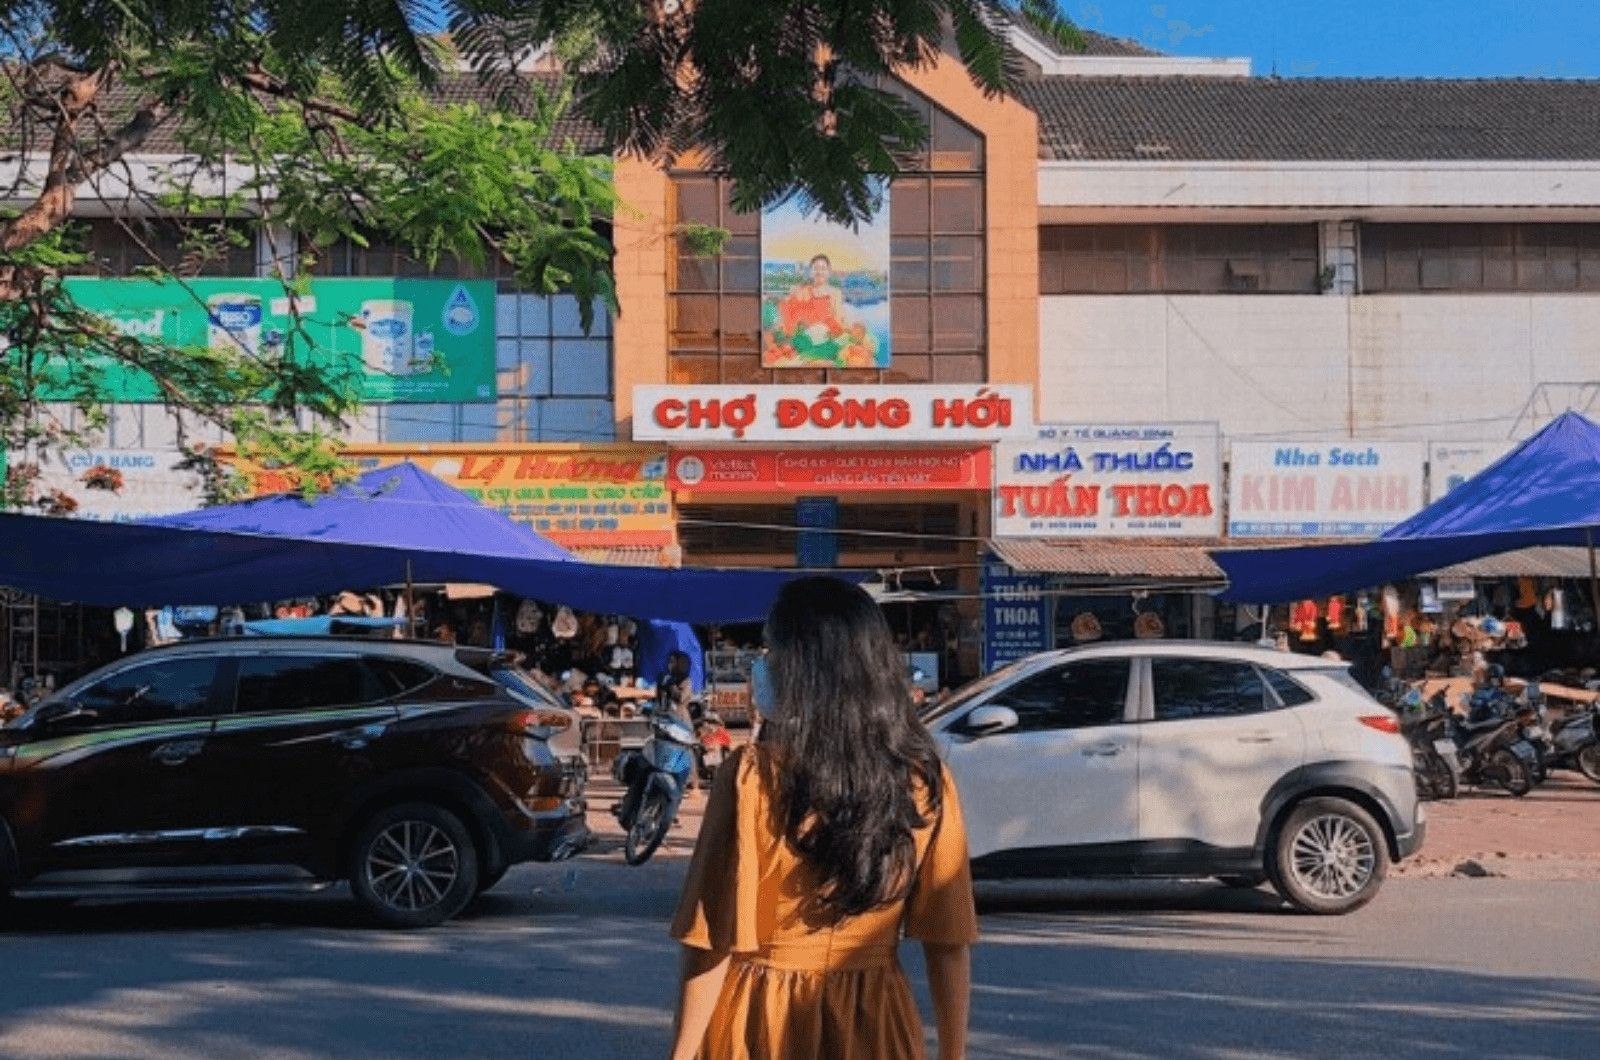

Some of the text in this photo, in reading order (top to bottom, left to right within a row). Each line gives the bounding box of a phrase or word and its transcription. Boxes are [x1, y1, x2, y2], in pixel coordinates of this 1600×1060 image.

[653, 387, 1013, 438] CHỢ ĐỒNG HỚI
[1018, 442, 1194, 471] NHÀ THUỐC
[999, 474, 1213, 517] TUẤN THOA
[1240, 475, 1317, 512] KIM
[1331, 475, 1410, 512] ANH
[994, 606, 1041, 626] THOA
